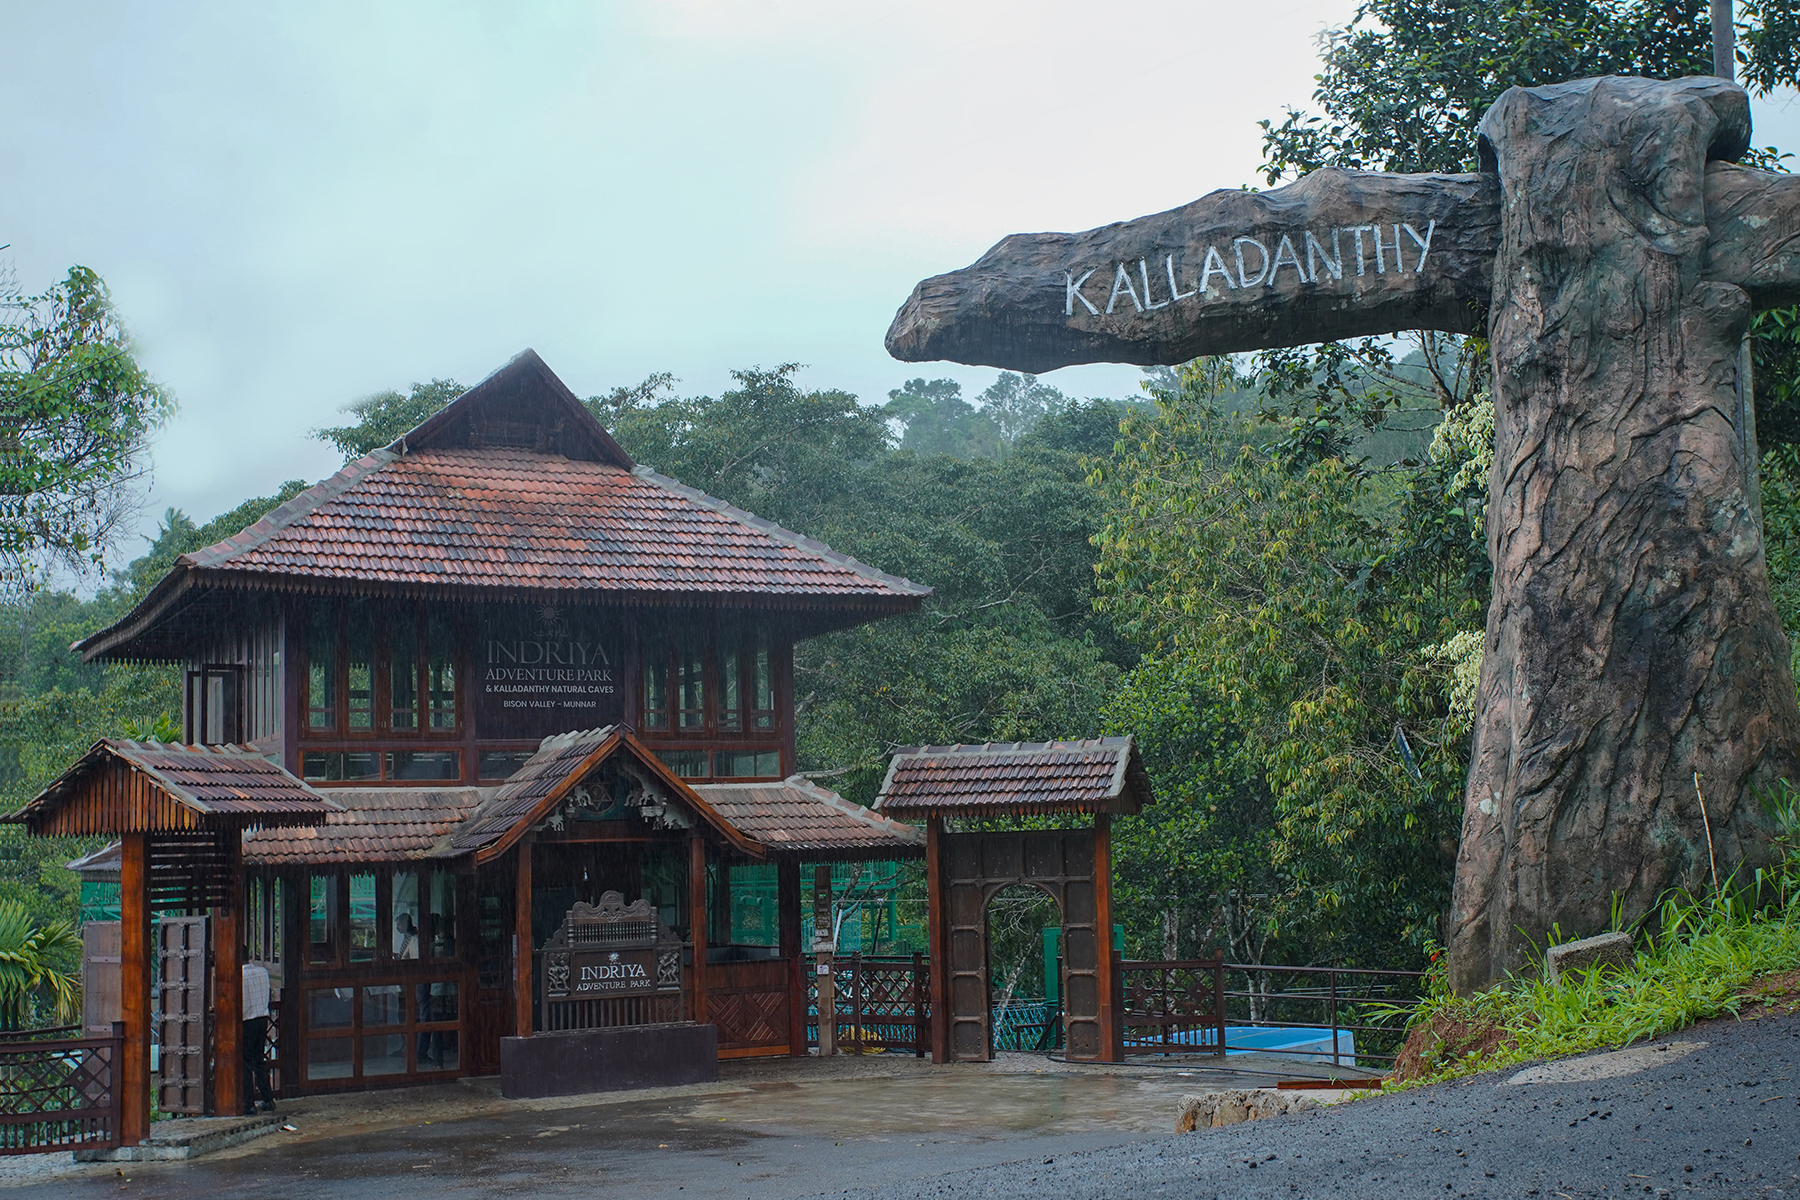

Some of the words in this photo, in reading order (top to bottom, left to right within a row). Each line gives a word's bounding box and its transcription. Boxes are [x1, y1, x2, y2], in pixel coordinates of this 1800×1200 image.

[1065, 219, 1436, 316] KALLADANTHY
[487, 640, 610, 665] INDRIYA
[485, 668, 575, 681] ADVENTURE
[577, 669, 613, 681] PARK
[485, 684, 493, 693] &
[493, 685, 550, 693] KALLADANTHY
[551, 685, 587, 694] NATURAL
[587, 686, 614, 694] CAVES
[503, 700, 528, 708] BISON
[581, 964, 647, 981] INDRIYA
[576, 981, 626, 991] ADVENTURE
[630, 979, 651, 988] PARK
